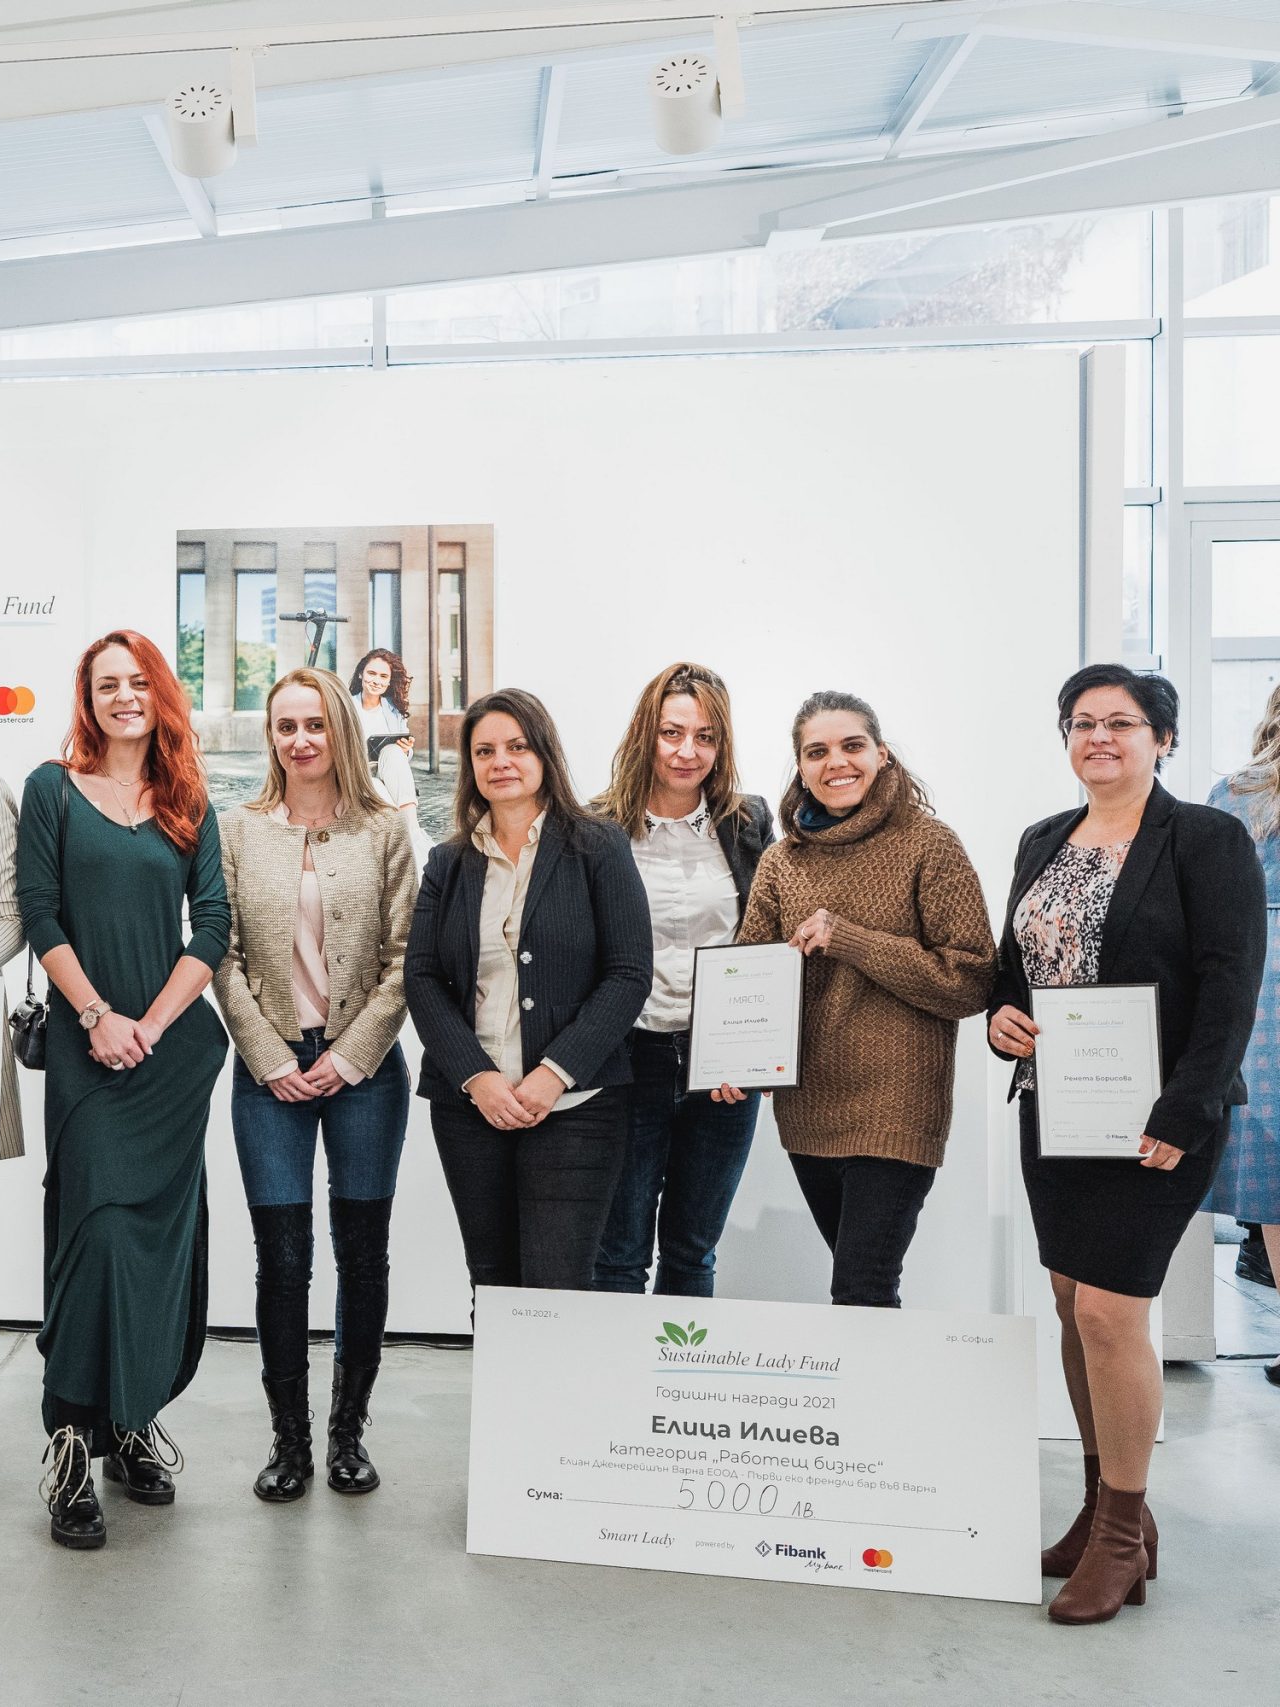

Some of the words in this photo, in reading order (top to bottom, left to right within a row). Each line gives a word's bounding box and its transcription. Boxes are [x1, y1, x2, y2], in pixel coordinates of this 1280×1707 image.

[3, 595, 56, 616] Fund
[1082, 1047, 1119, 1058] МЯСТО
[511, 1308, 552, 1318] 04.11.2021
[961, 1334, 994, 1344] София
[658, 1346, 751, 1368] Sustainable
[755, 1353, 796, 1373] Lady
[799, 1355, 841, 1372] Fund
[656, 1385, 727, 1402] Годишни
[732, 1392, 799, 1409] награди
[802, 1395, 836, 1409] 2021
[651, 1415, 731, 1441] Елица
[740, 1421, 840, 1447] Илиева
[609, 1441, 708, 1462] категория
[713, 1449, 809, 1470] „Работещ
[814, 1456, 884, 1474] бизнес“
[560, 1456, 590, 1467] Елиан
[592, 1459, 669, 1474] Дженерейшън
[672, 1466, 704, 1476] Варна
[707, 1468, 739, 1479] ЕООД
[747, 1470, 783, 1482] Първи
[785, 1473, 803, 1483] еко
[806, 1475, 854, 1489] френдли
[857, 1478, 876, 1490] бар
[880, 1480, 900, 1490] във
[902, 1483, 937, 1494] Варна
[527, 1488, 563, 1501] Сума:
[677, 1478, 778, 1514] 5000
[598, 1527, 638, 1543] Smart
[642, 1531, 675, 1548] Lady
[695, 1540, 726, 1549] powered
[726, 1542, 735, 1550] by
[775, 1543, 826, 1560] Fibank
